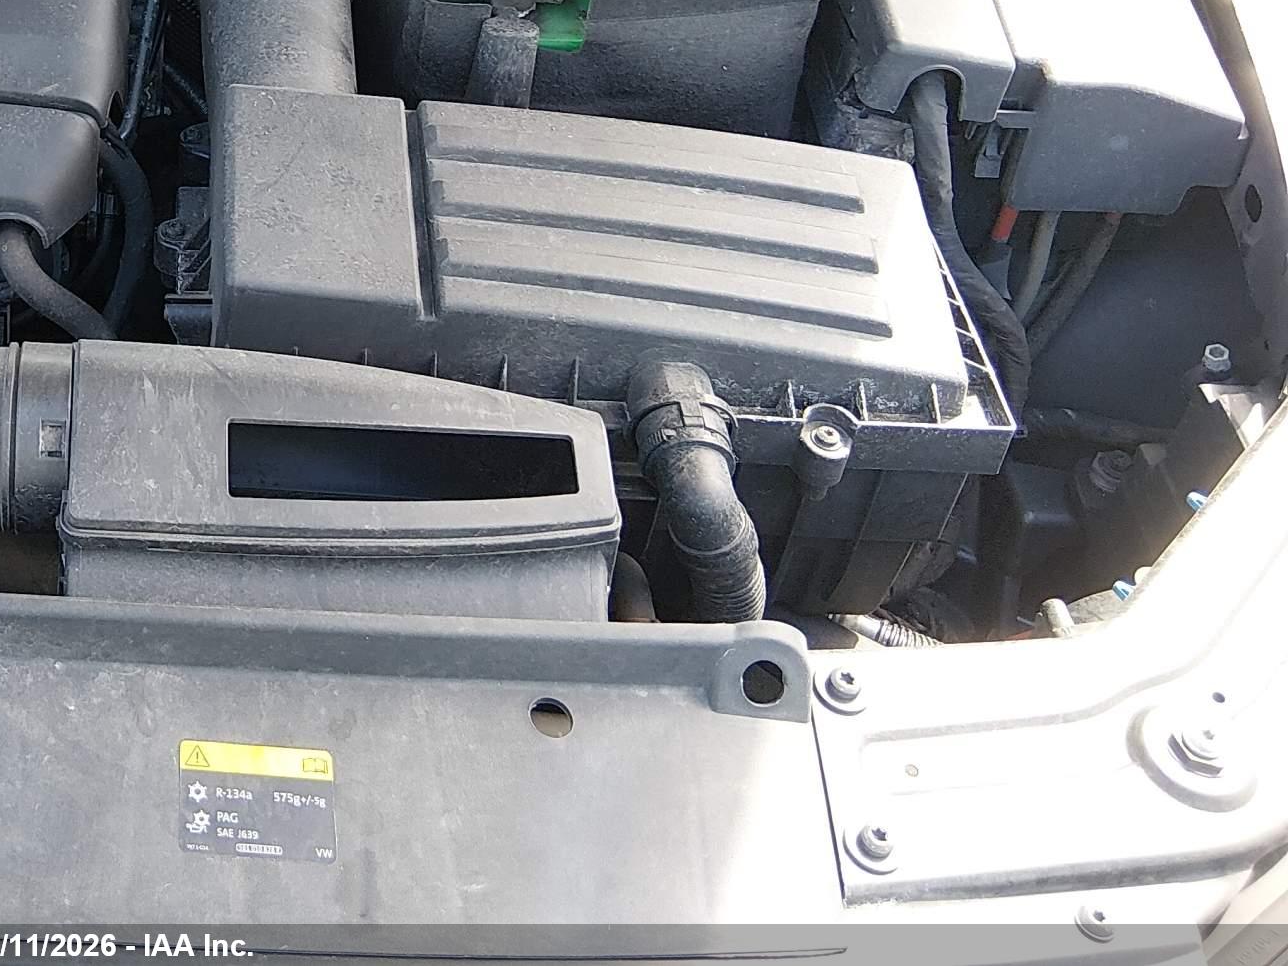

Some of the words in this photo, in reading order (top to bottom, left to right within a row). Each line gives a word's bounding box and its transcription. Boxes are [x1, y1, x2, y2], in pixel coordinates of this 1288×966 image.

[216, 787, 253, 800] R-134a
[216, 811, 238, 824] PAG
[216, 828, 234, 838] SAE
[238, 830, 258, 839] J639
[315, 848, 333, 858] VW
